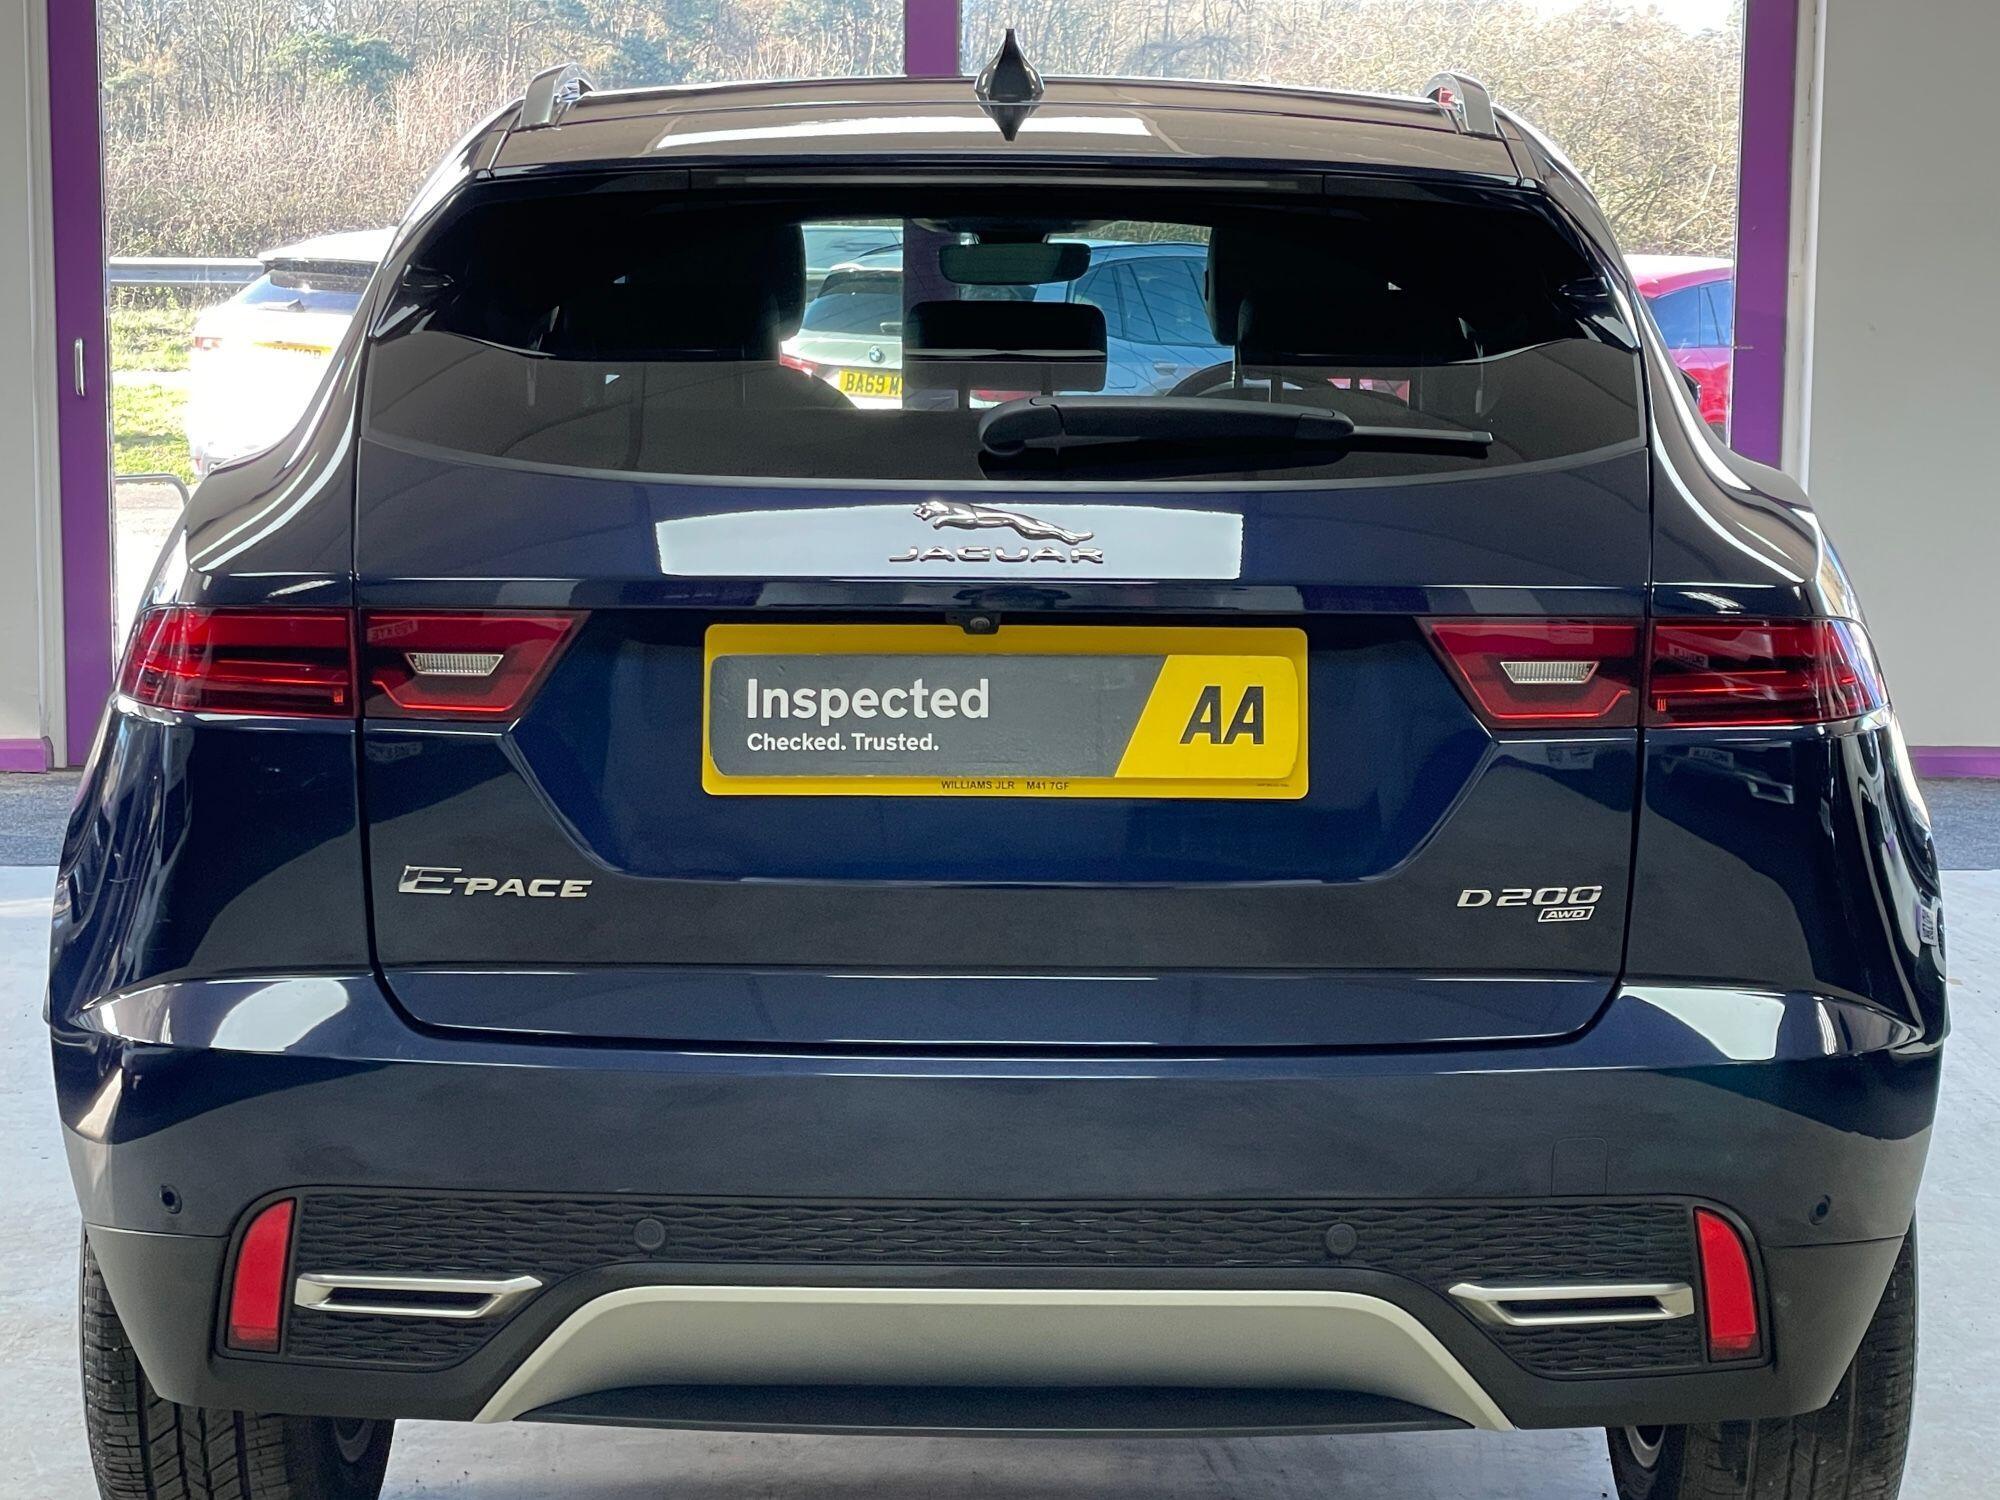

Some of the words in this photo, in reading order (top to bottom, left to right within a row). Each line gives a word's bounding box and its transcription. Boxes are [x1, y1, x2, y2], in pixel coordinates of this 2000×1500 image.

[844, 373, 885, 394] BA69
[889, 546, 1104, 564] JAGUAR
[747, 678, 989, 726] Inspected
[1179, 685, 1264, 745] AA
[747, 732, 847, 751] Checked.
[851, 732, 940, 751] Trusted.
[941, 780, 993, 790] WILLIAMS
[995, 780, 1015, 790] JLR
[1026, 780, 1046, 790] M41
[398, 865, 593, 898] E-PACE
[1544, 908, 1587, 920] AWD
